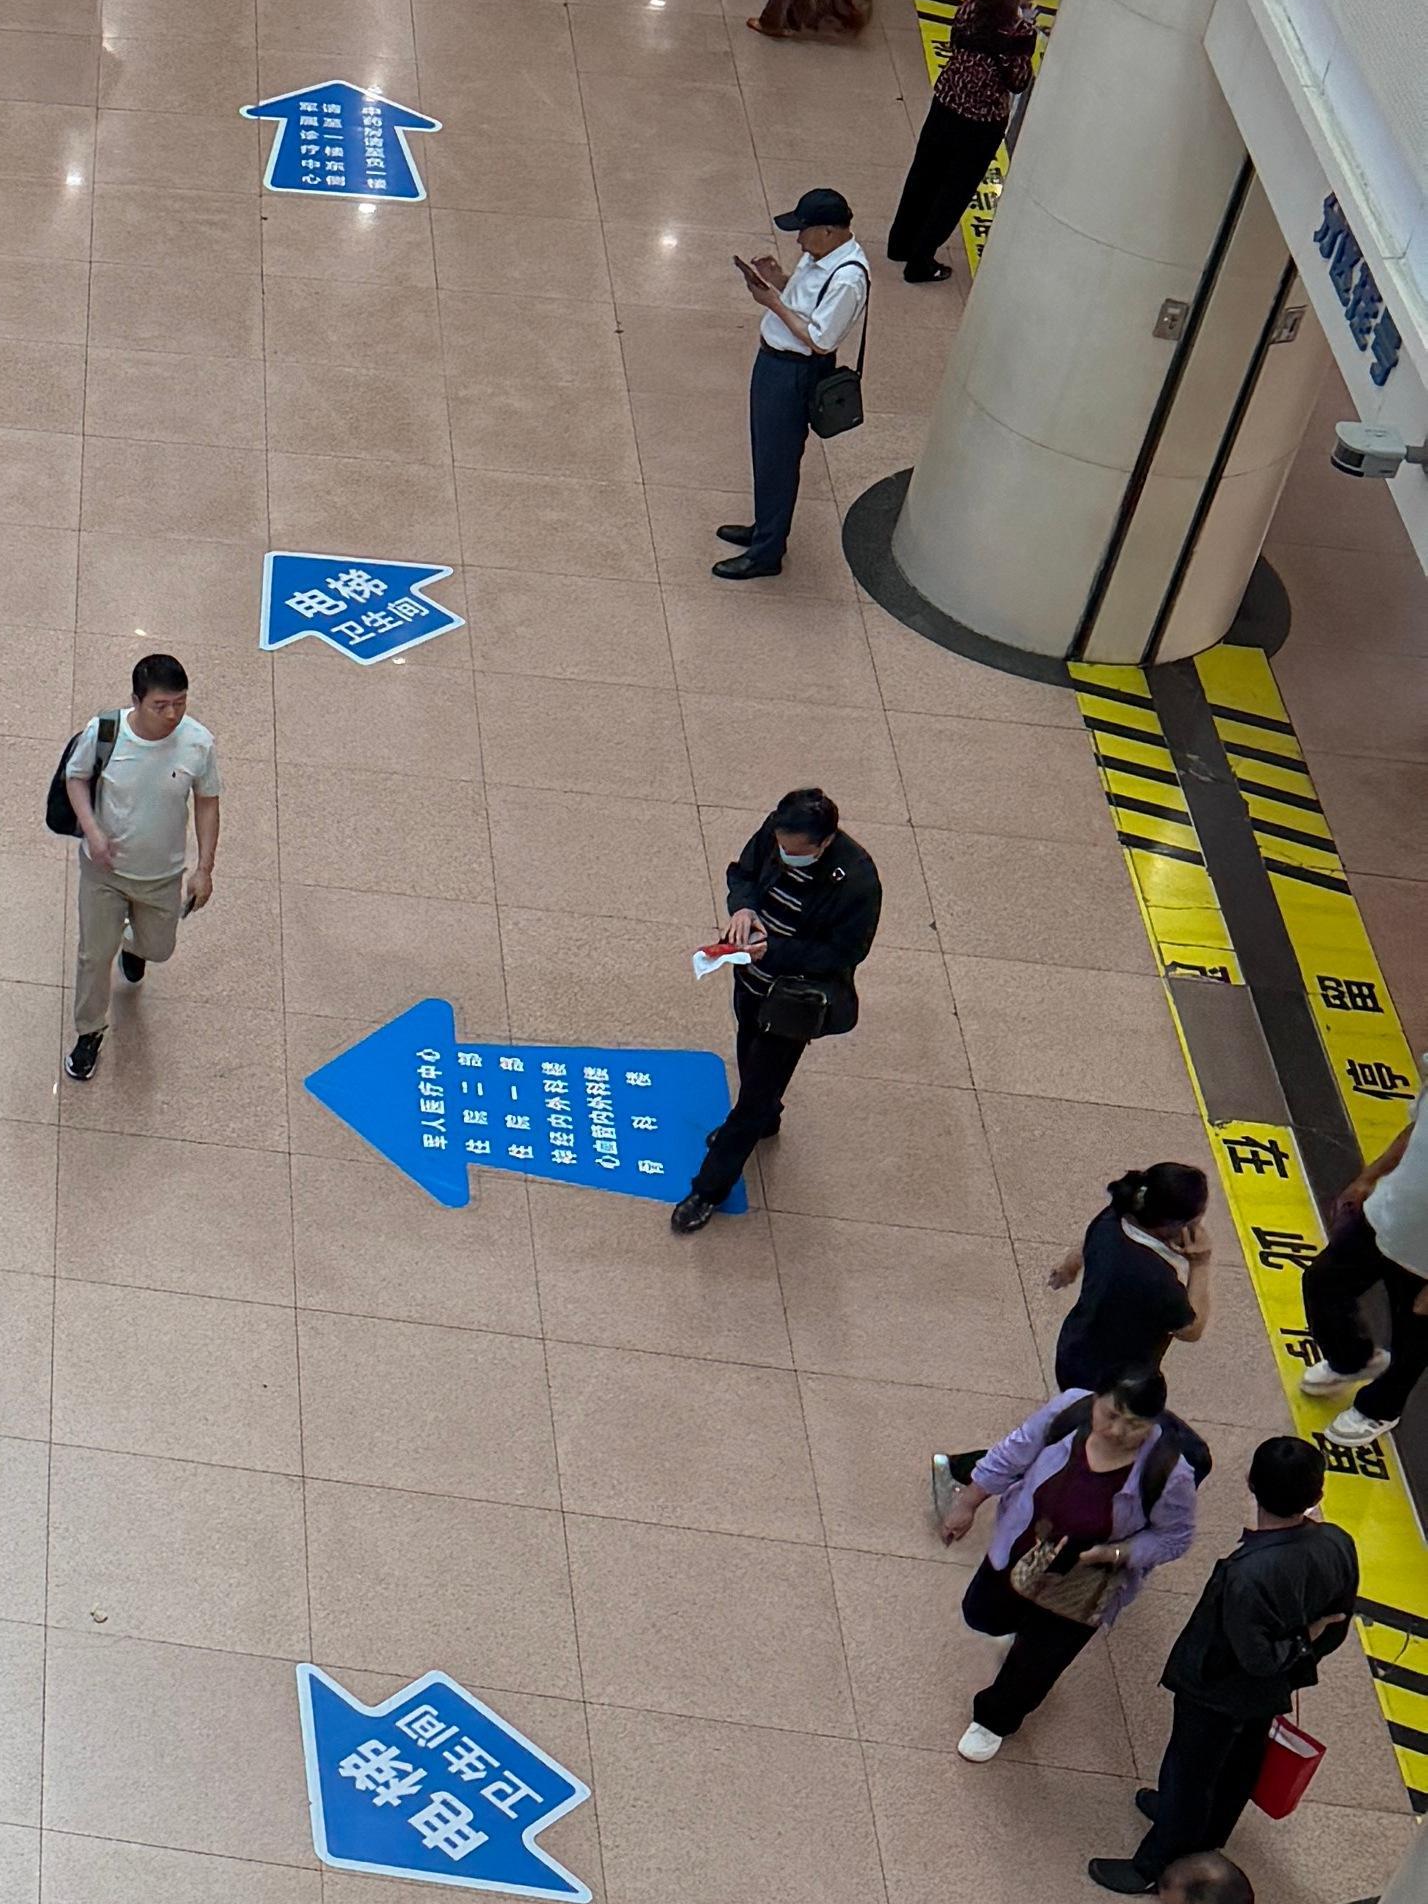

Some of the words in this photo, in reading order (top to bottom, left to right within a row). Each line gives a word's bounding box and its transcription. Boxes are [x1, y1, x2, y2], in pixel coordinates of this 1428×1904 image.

[284, 569, 388, 618] 电梯
[331, 597, 430, 645] 卫生间
[416, 1047, 448, 1150] 军人医疗中心
[457, 1051, 491, 1155] 住院二部
[499, 1056, 534, 1160] 住院一部
[541, 1060, 577, 1166] 神经内外科楼
[583, 1065, 621, 1171] 心血管内外科楼
[625, 1070, 665, 1176] 骨科楼
[338, 1739, 489, 1861] 电梯
[395, 1704, 543, 1819] 卫生间
